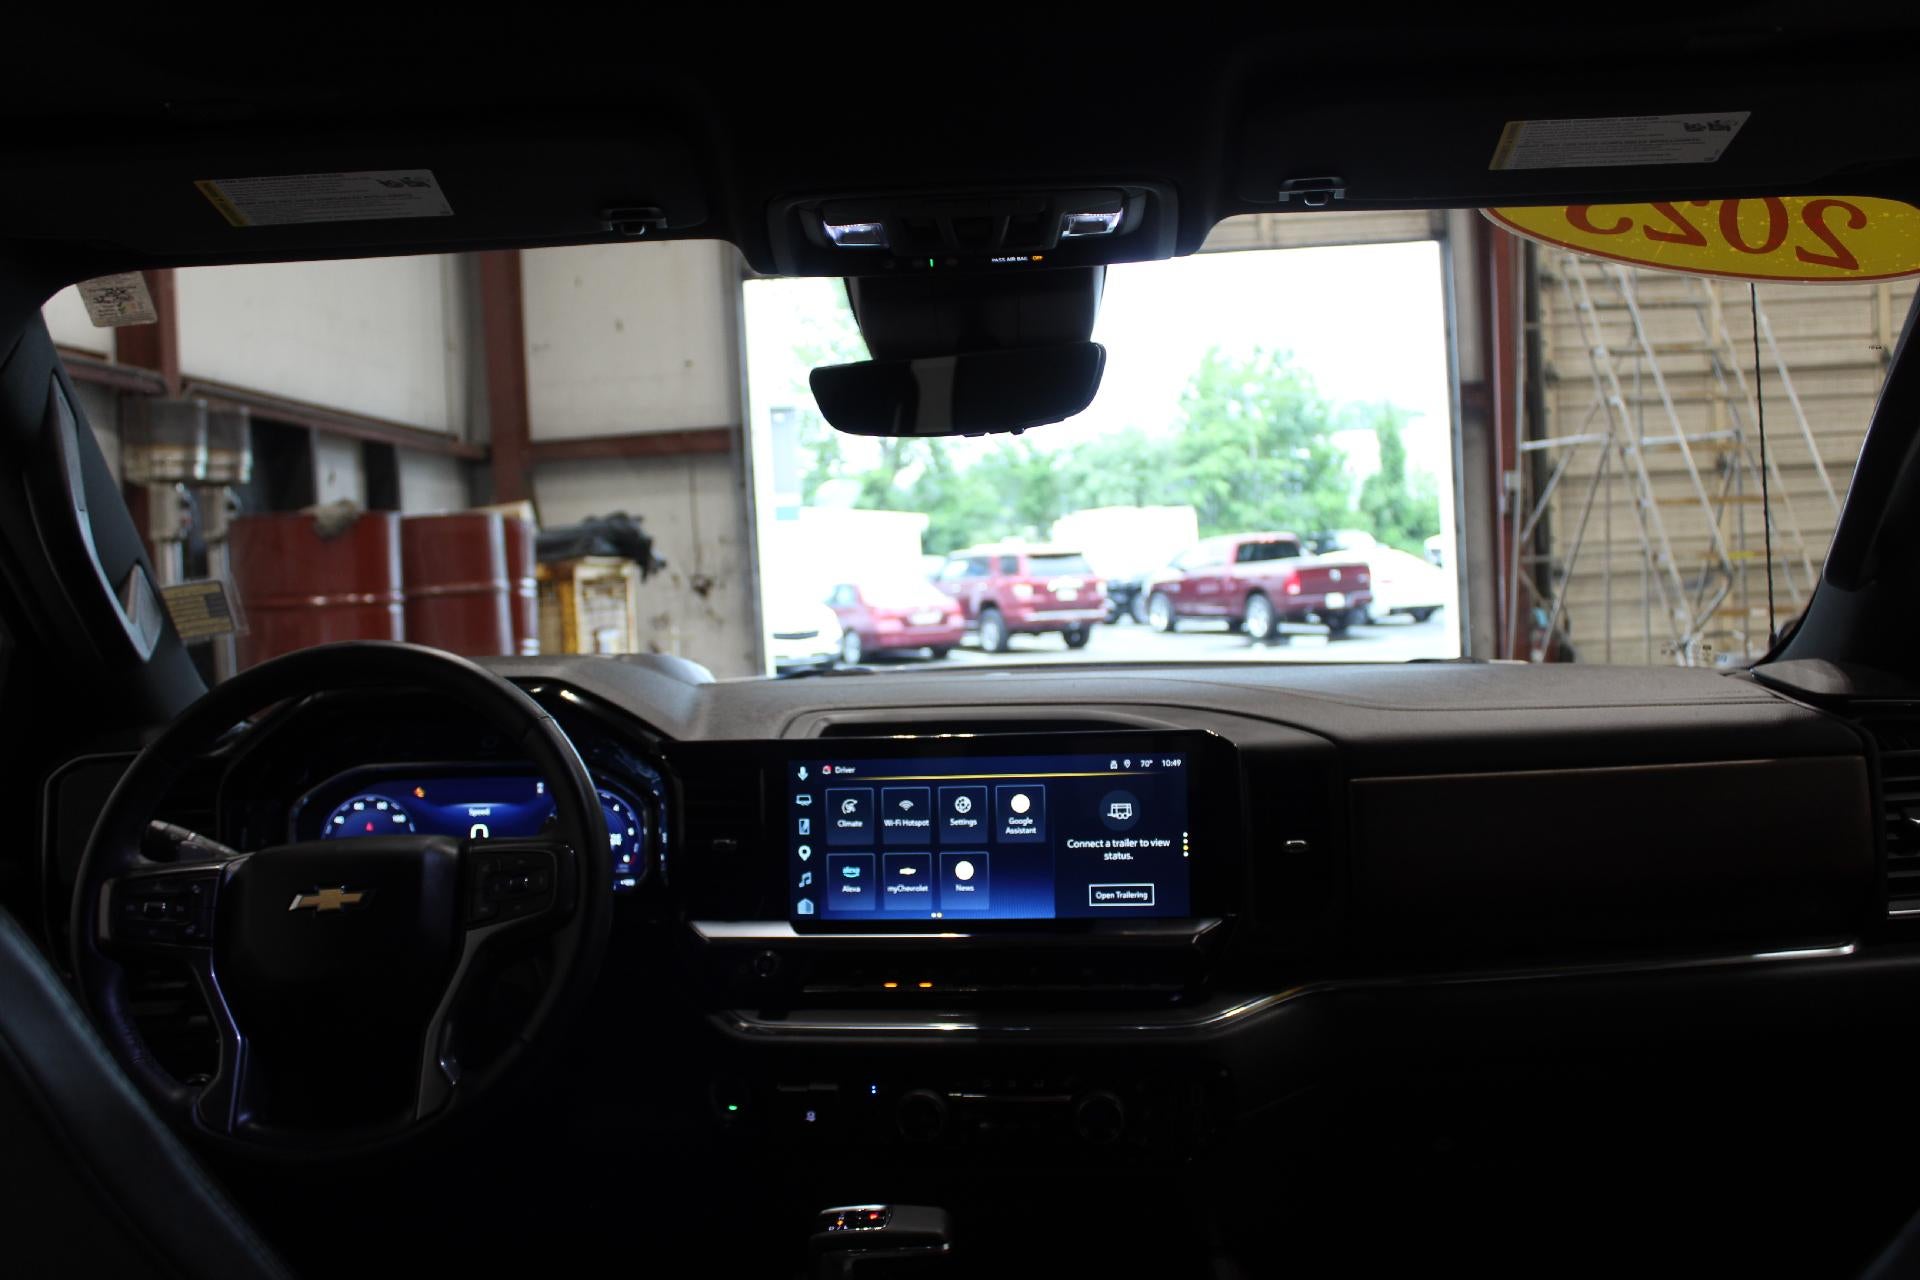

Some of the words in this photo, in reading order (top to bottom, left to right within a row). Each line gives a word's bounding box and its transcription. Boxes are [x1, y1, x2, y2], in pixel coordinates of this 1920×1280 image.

[1162, 759, 1182, 767] 10:49
[834, 766, 856, 774] Driver
[837, 820, 863, 828] Climate
[884, 819, 901, 827] Wi-Fi
[902, 819, 930, 828] Hotspot
[950, 818, 978, 827] Settings
[1008, 817, 1033, 826] Google
[1005, 826, 1037, 835] Assistant
[1066, 839, 1104, 848] Connect
[1112, 838, 1138, 848] trailer
[1139, 839, 1150, 847] to
[1150, 838, 1171, 847] view
[1103, 851, 1134, 860] status.
[842, 885, 861, 893] Alexa
[887, 884, 928, 893] myChevrolet
[955, 884, 975, 892] News
[1095, 891, 1115, 900] Open
[1115, 890, 1148, 900] Trailering
